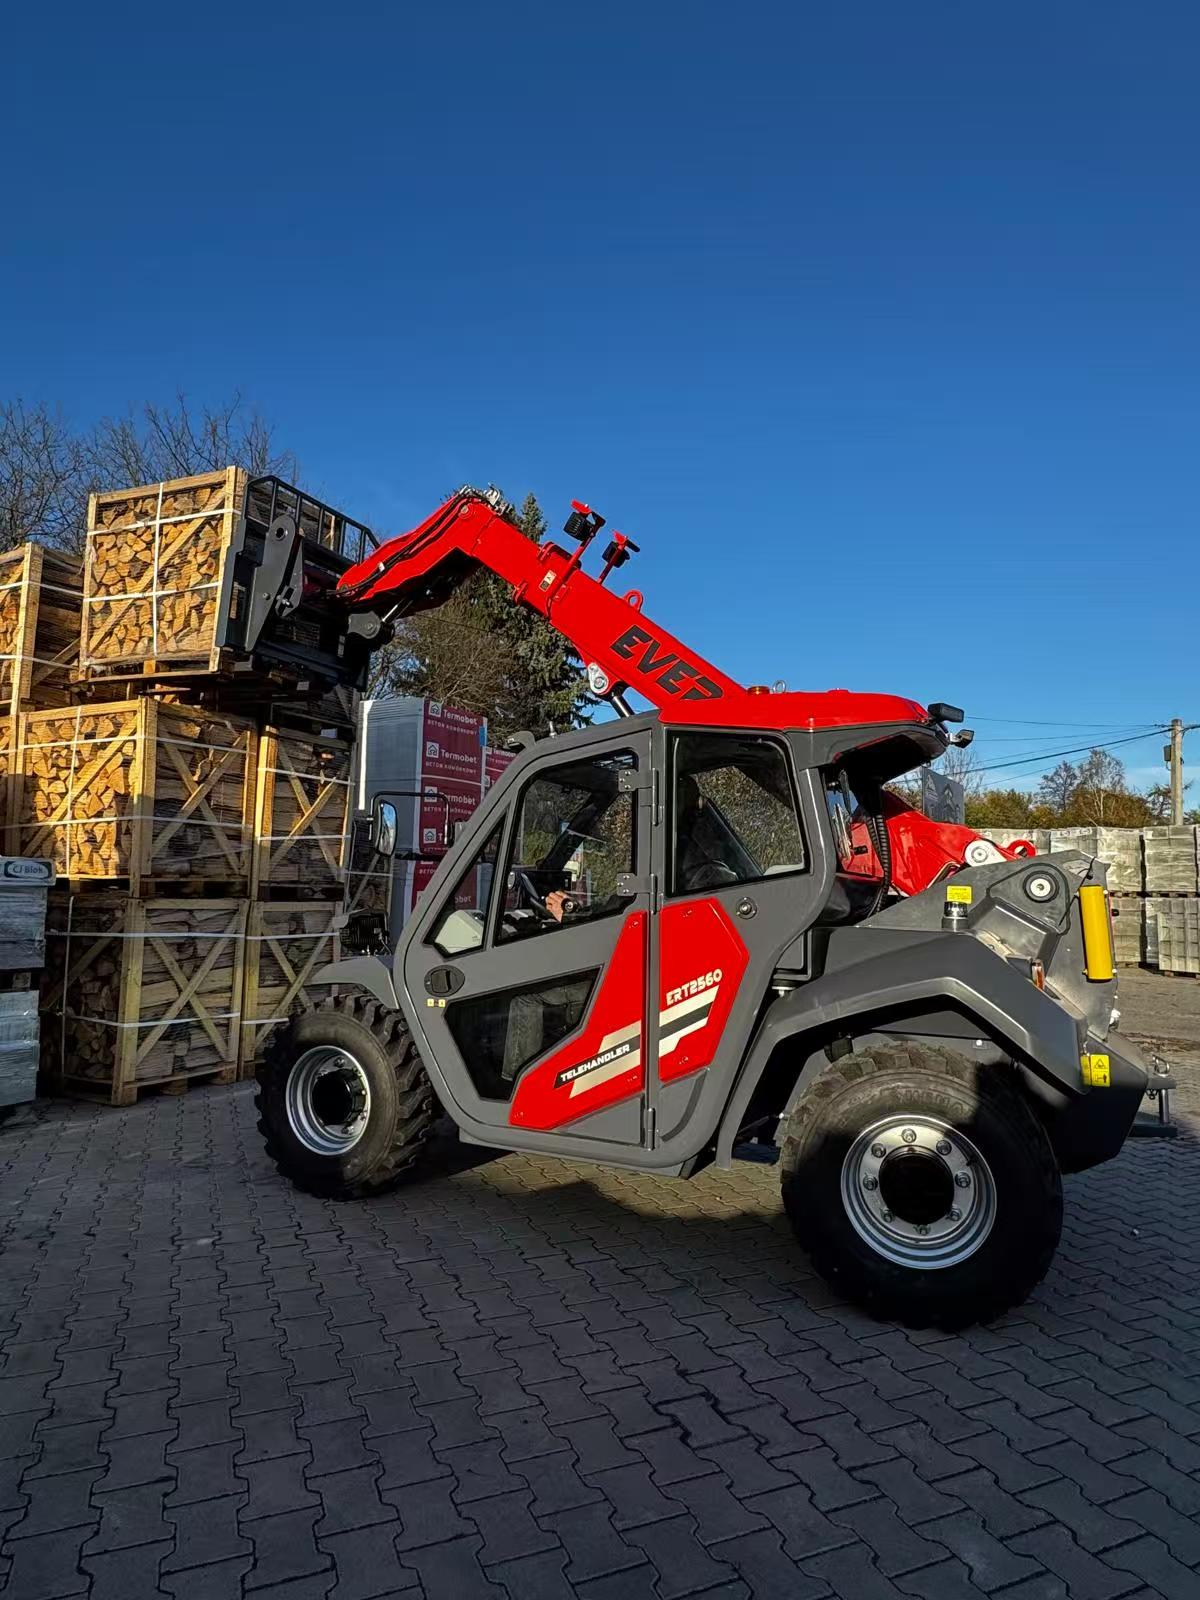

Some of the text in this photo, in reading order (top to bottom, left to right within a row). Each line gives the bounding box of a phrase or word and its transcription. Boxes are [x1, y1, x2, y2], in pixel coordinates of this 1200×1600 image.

[427, 719, 445, 728] BETON
[443, 709, 478, 725] Termobet
[441, 749, 477, 764] Termobet
[425, 761, 444, 769] BETON
[440, 794, 476, 805] rmobet
[666, 968, 722, 1006] ERT2560
[560, 1044, 630, 1081] TELEHANDLER
